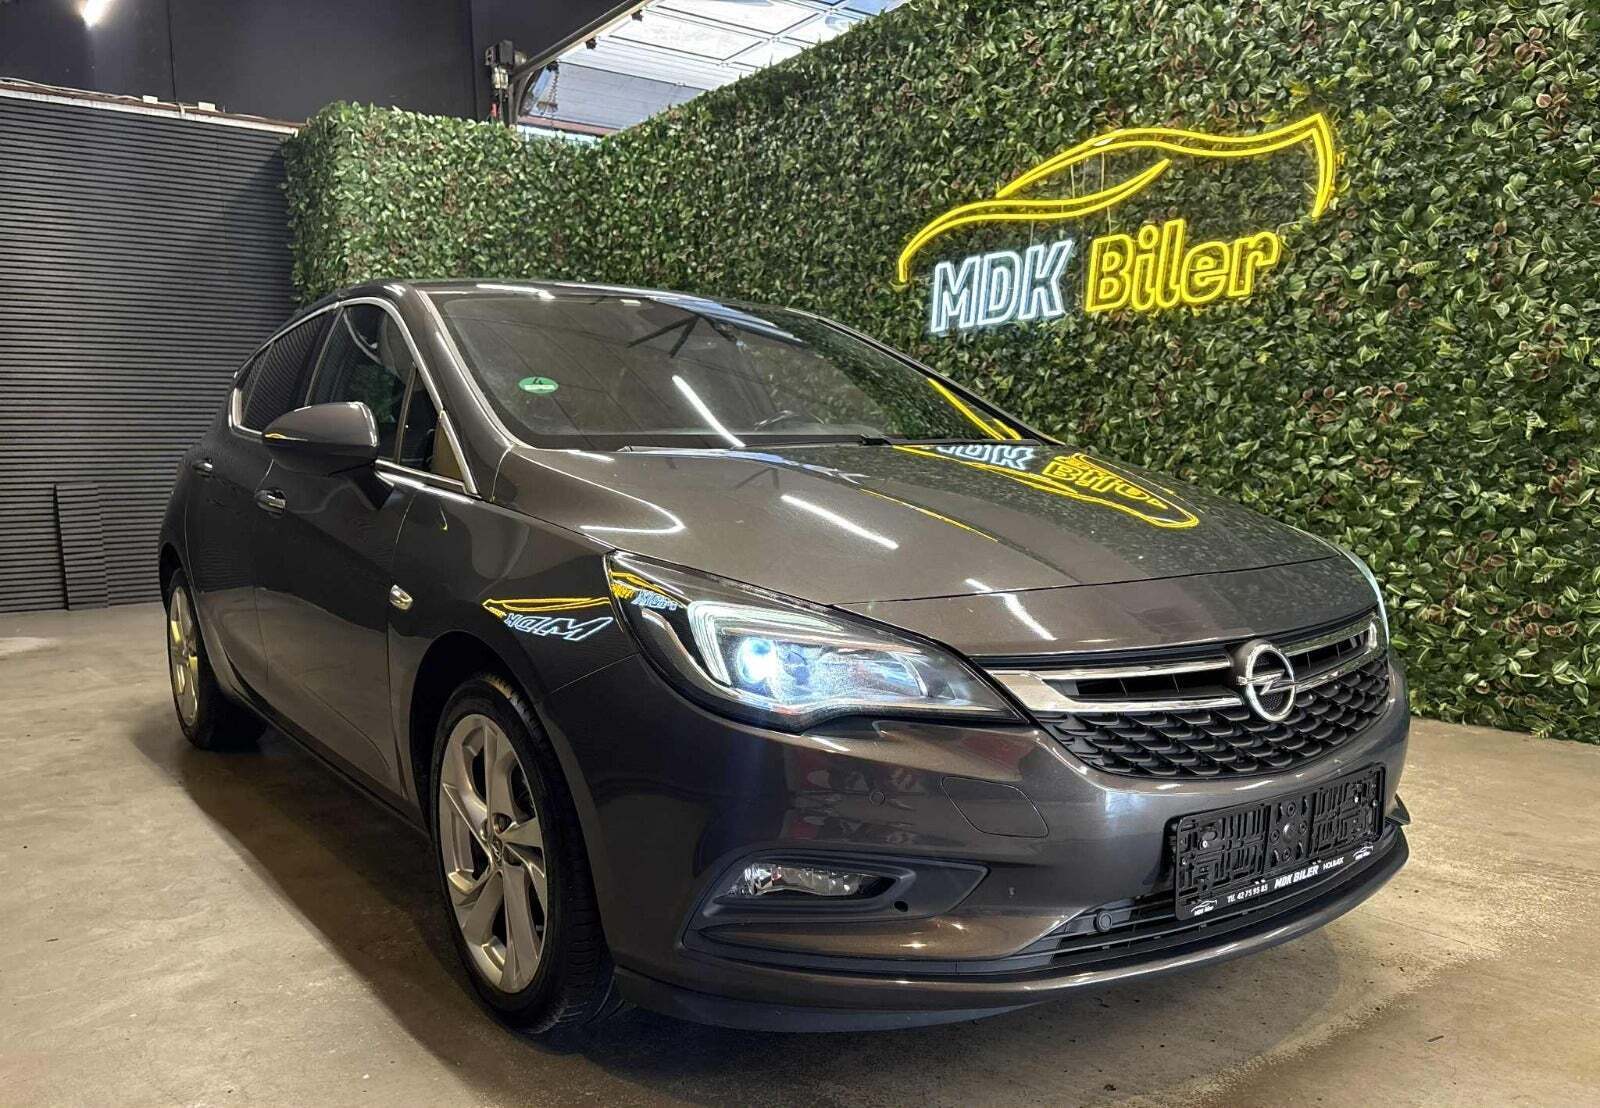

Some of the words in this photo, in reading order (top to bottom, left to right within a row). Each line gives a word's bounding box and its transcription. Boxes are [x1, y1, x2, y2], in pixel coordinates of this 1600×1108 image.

[929, 238, 1074, 333] MDK
[1085, 217, 1280, 313] Biler
[1274, 873, 1293, 889] MDK
[1293, 864, 1320, 883] BILER
